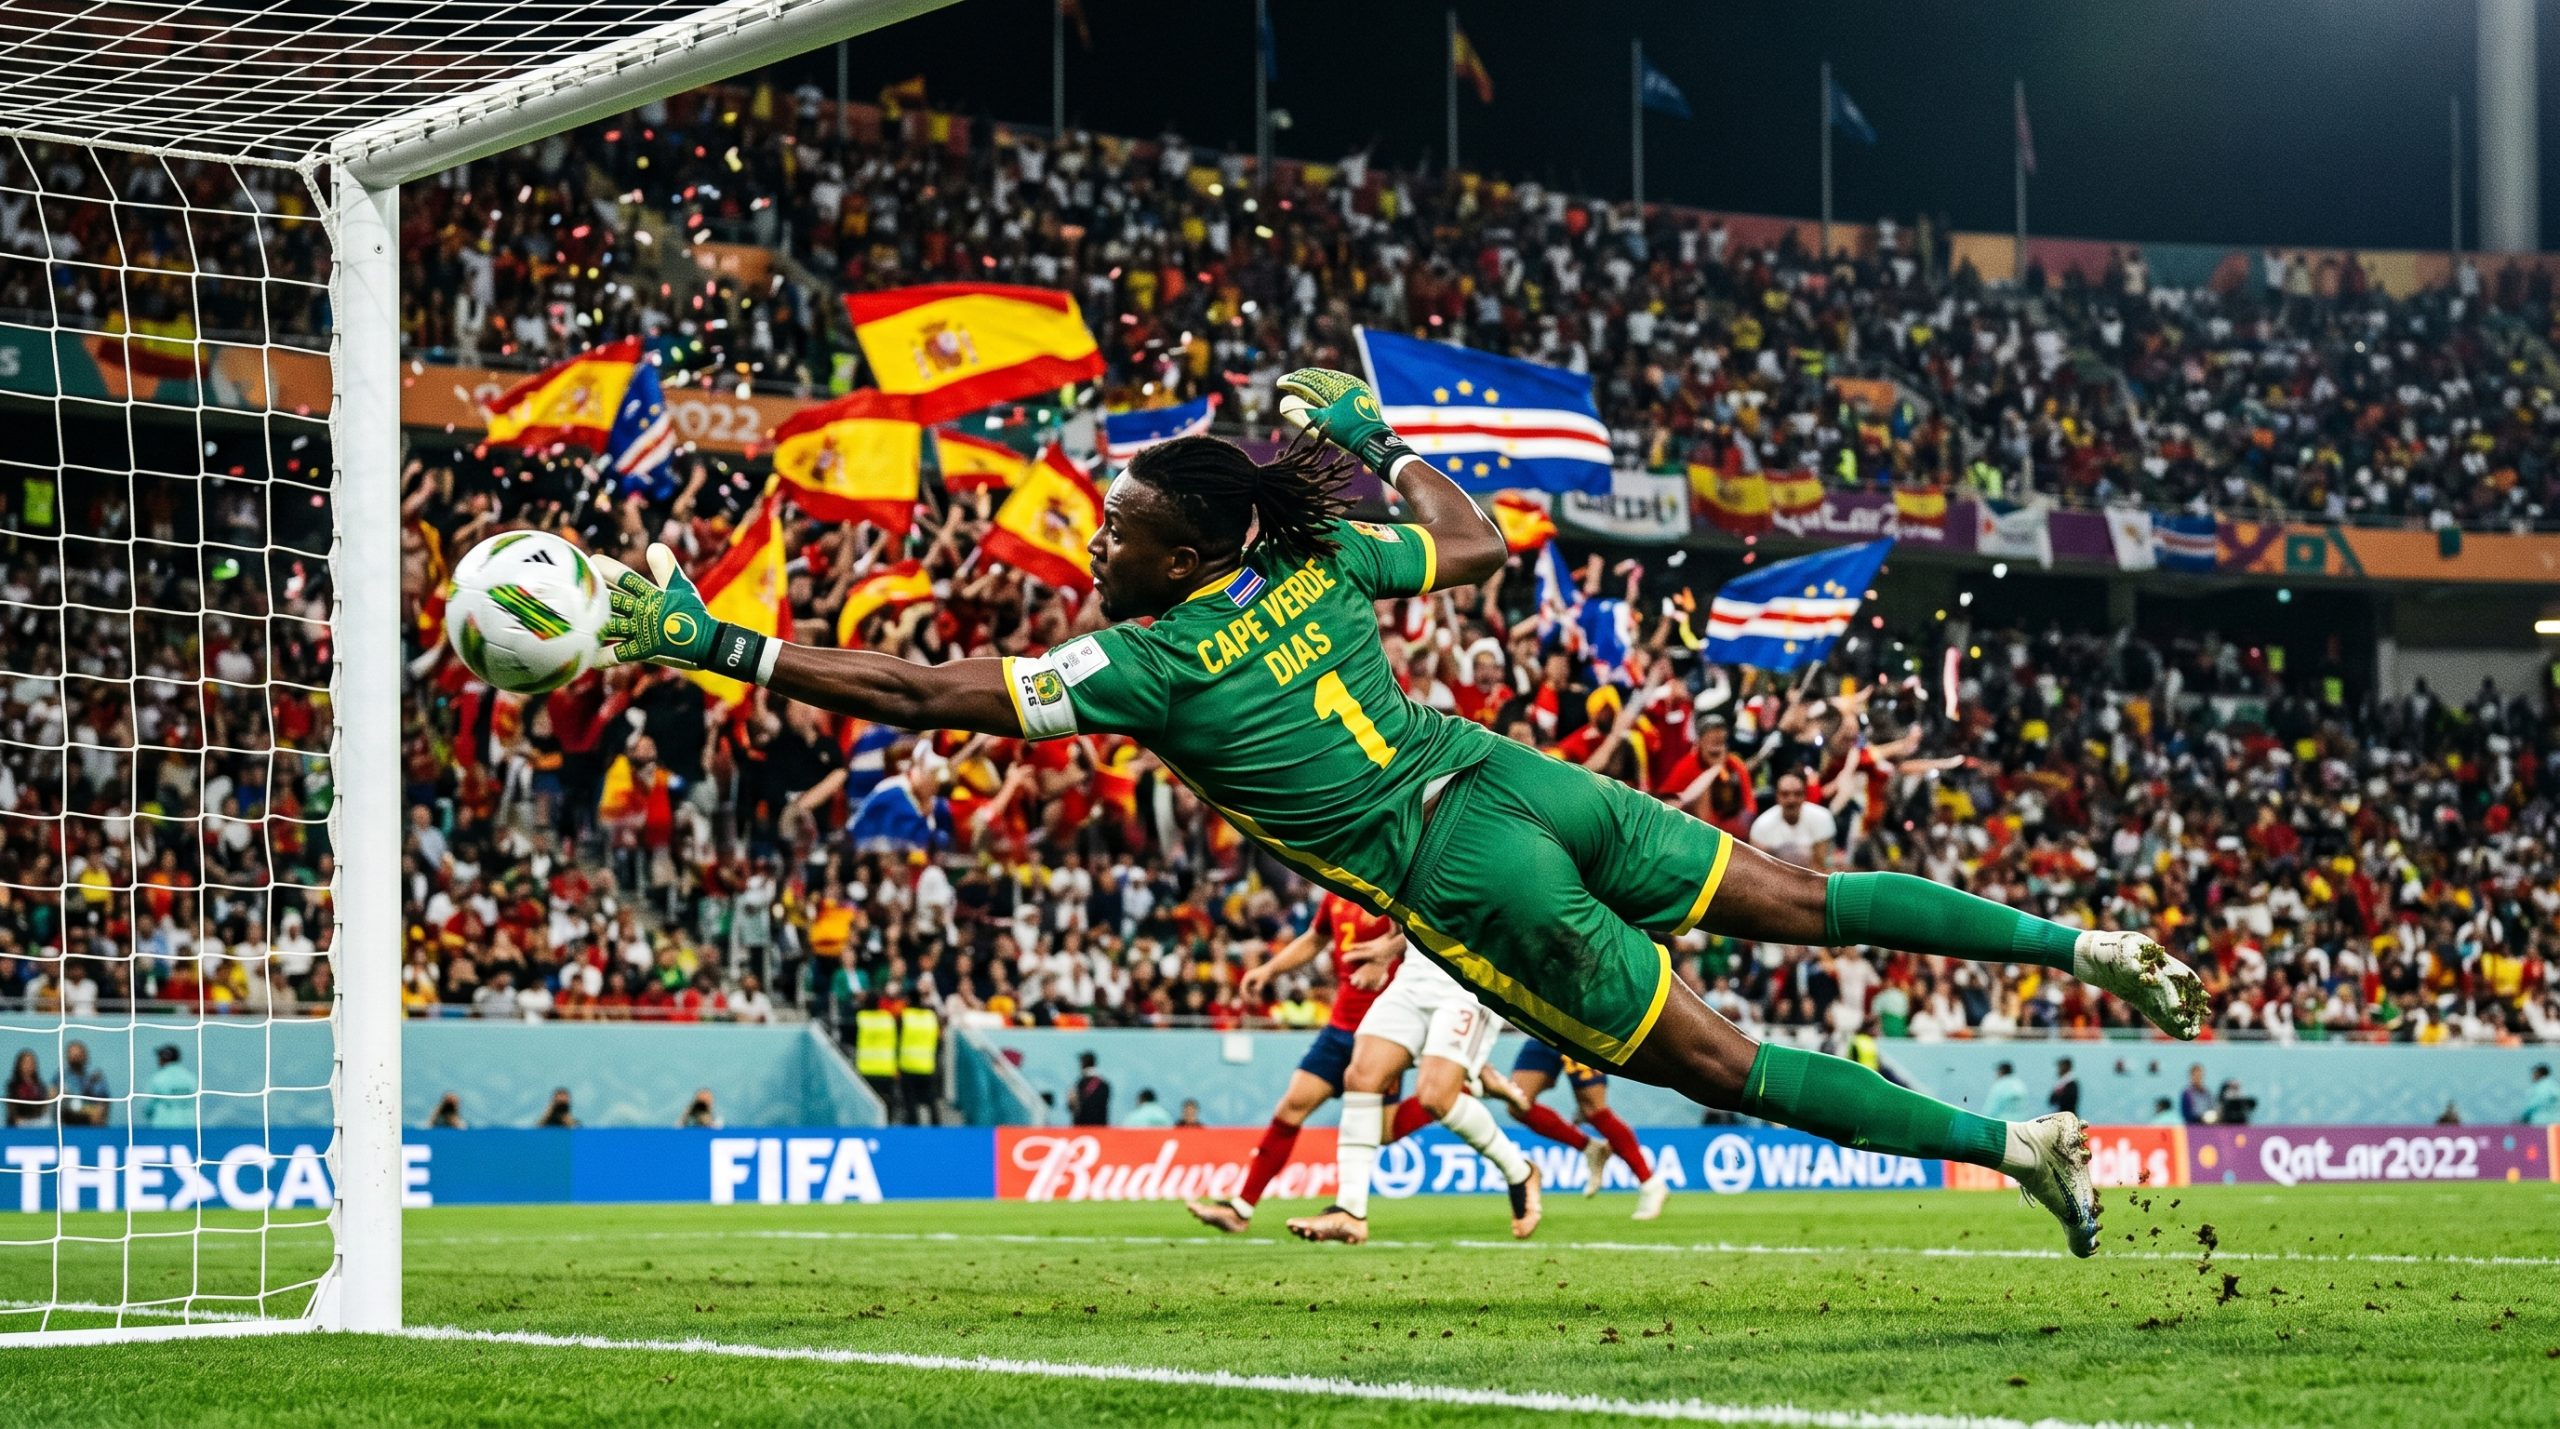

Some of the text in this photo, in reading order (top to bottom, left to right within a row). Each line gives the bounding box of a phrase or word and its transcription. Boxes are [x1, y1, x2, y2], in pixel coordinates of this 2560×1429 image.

[1197, 557, 1337, 675] CAPE VERDE
[1263, 621, 1332, 687] DIAS
[1313, 669, 1397, 769] 1
[709, 1137, 885, 1205] FIFA
